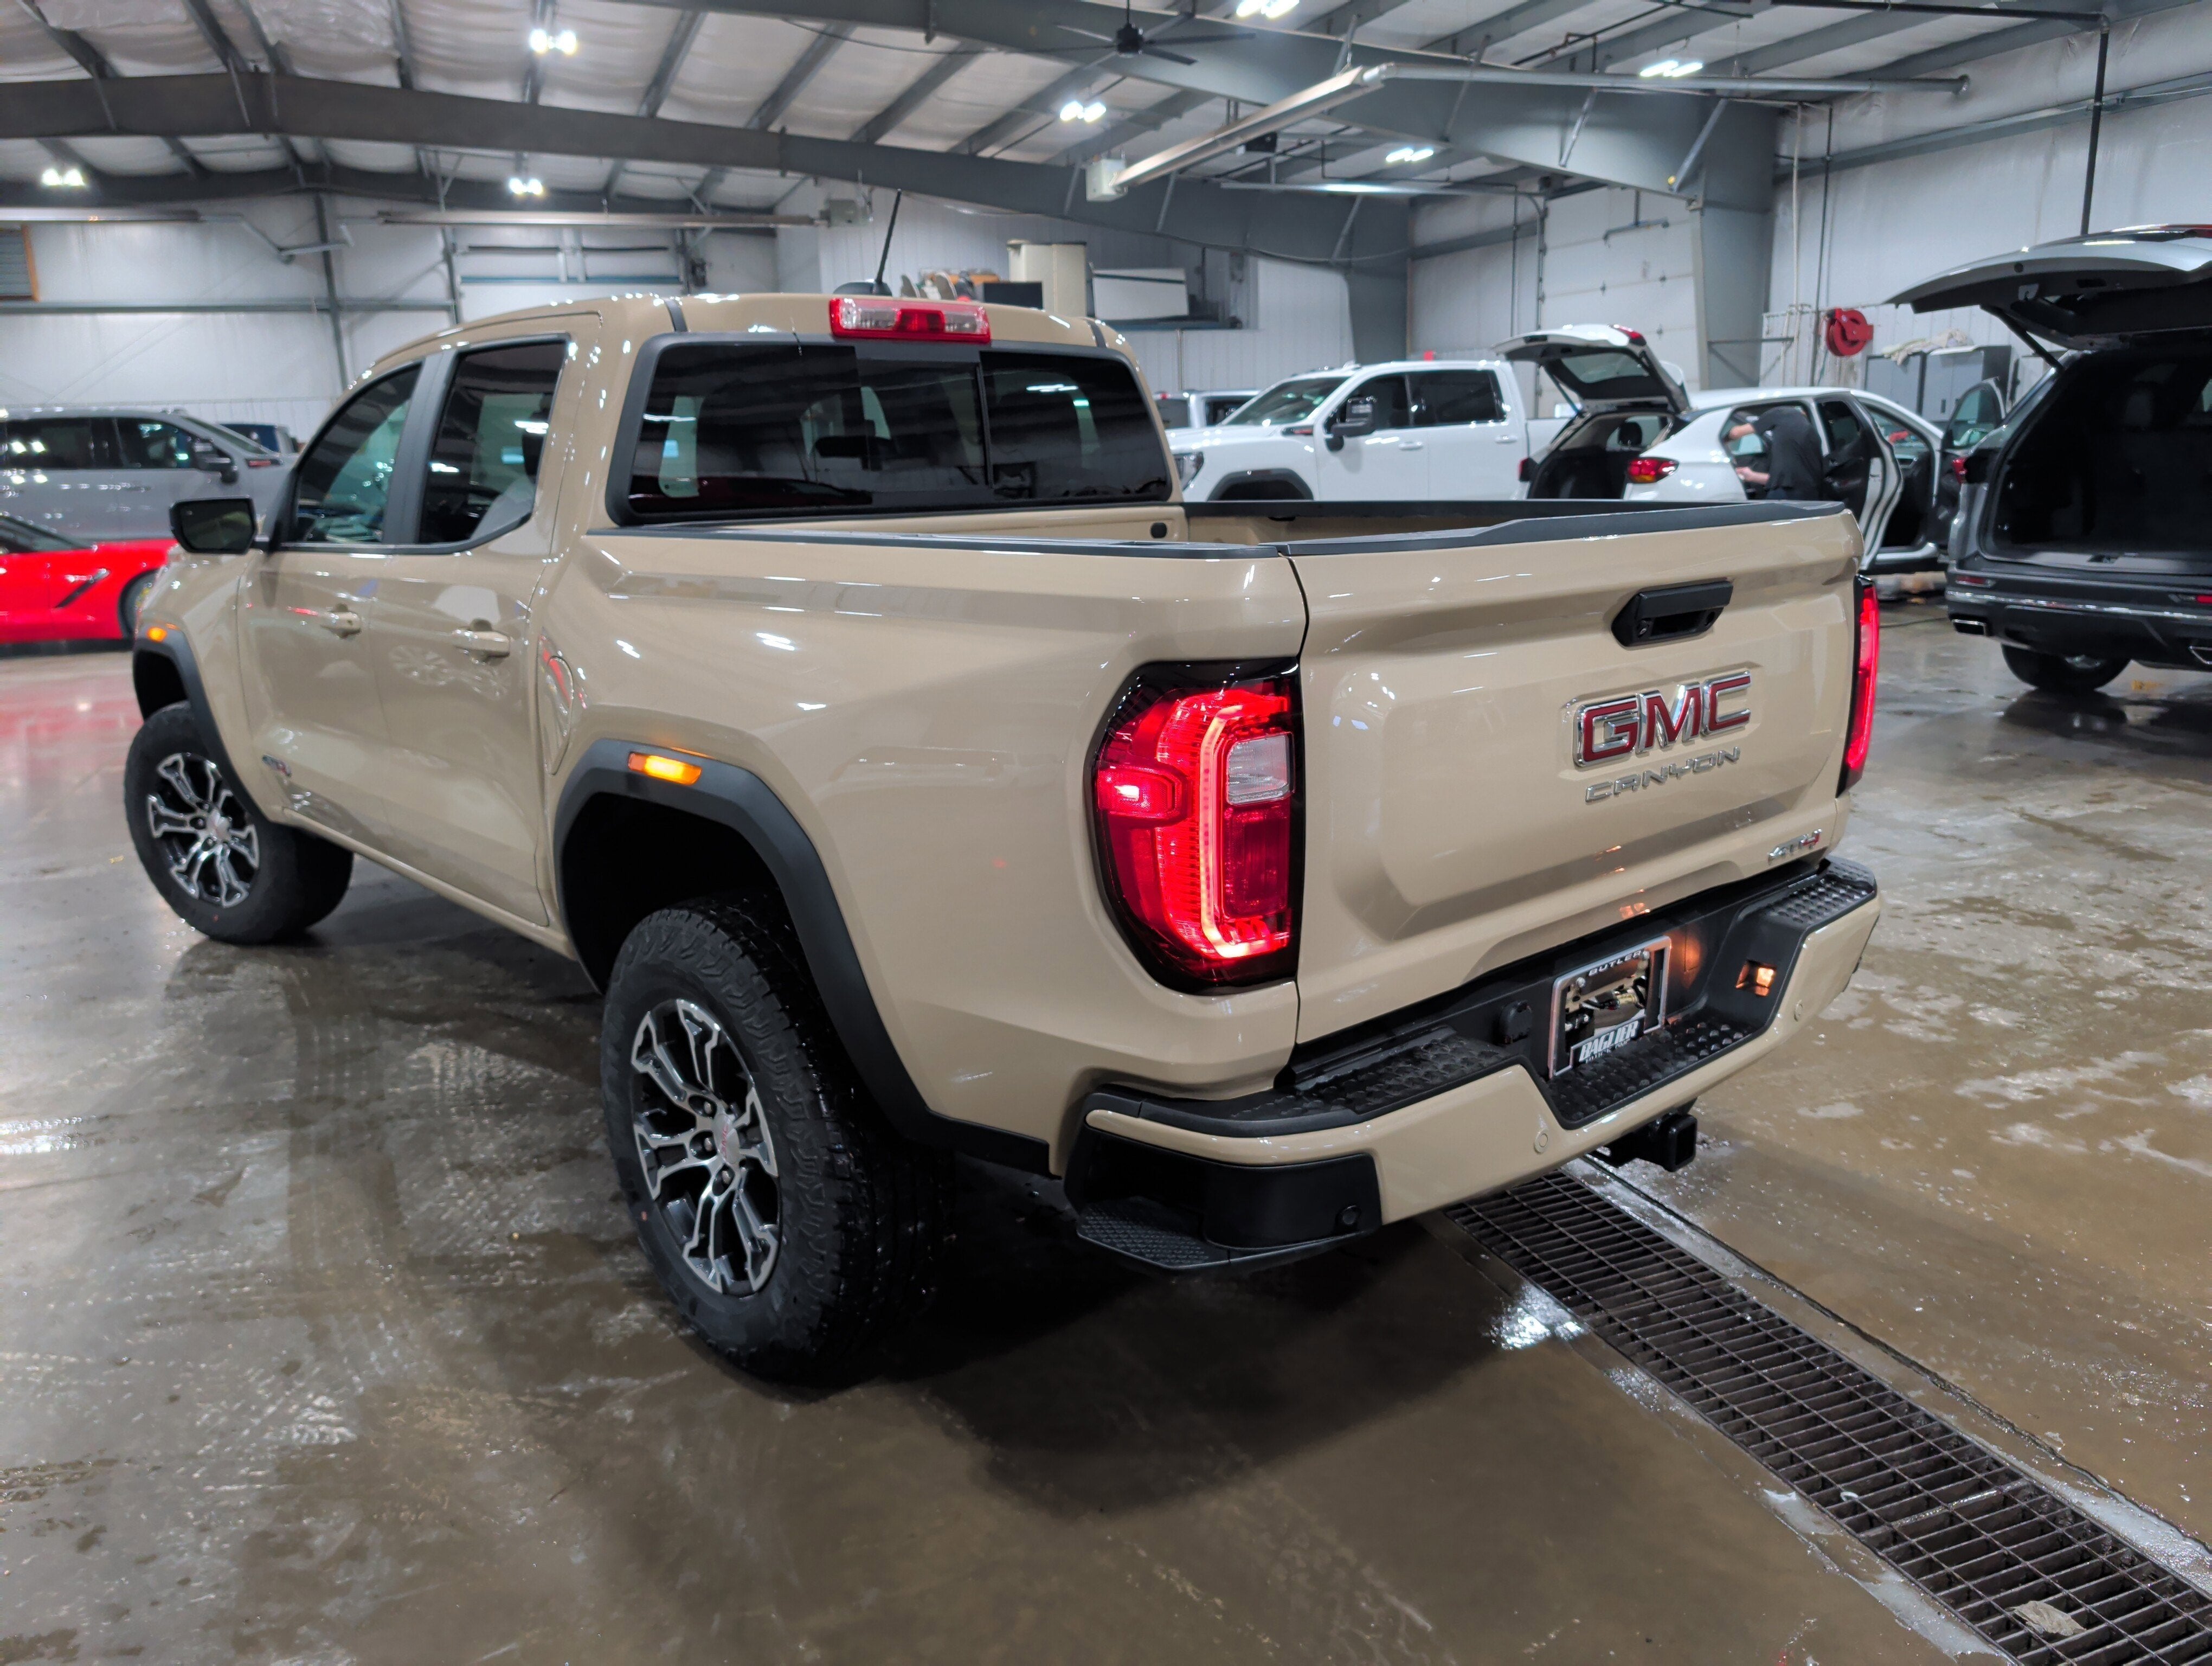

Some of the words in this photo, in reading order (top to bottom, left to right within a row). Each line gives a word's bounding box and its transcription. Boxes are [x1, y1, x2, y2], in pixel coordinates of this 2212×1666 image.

[1573, 671, 1751, 767] GMC
[1585, 747, 1741, 803] CANYON
[1588, 950, 1642, 977] BUTLER
